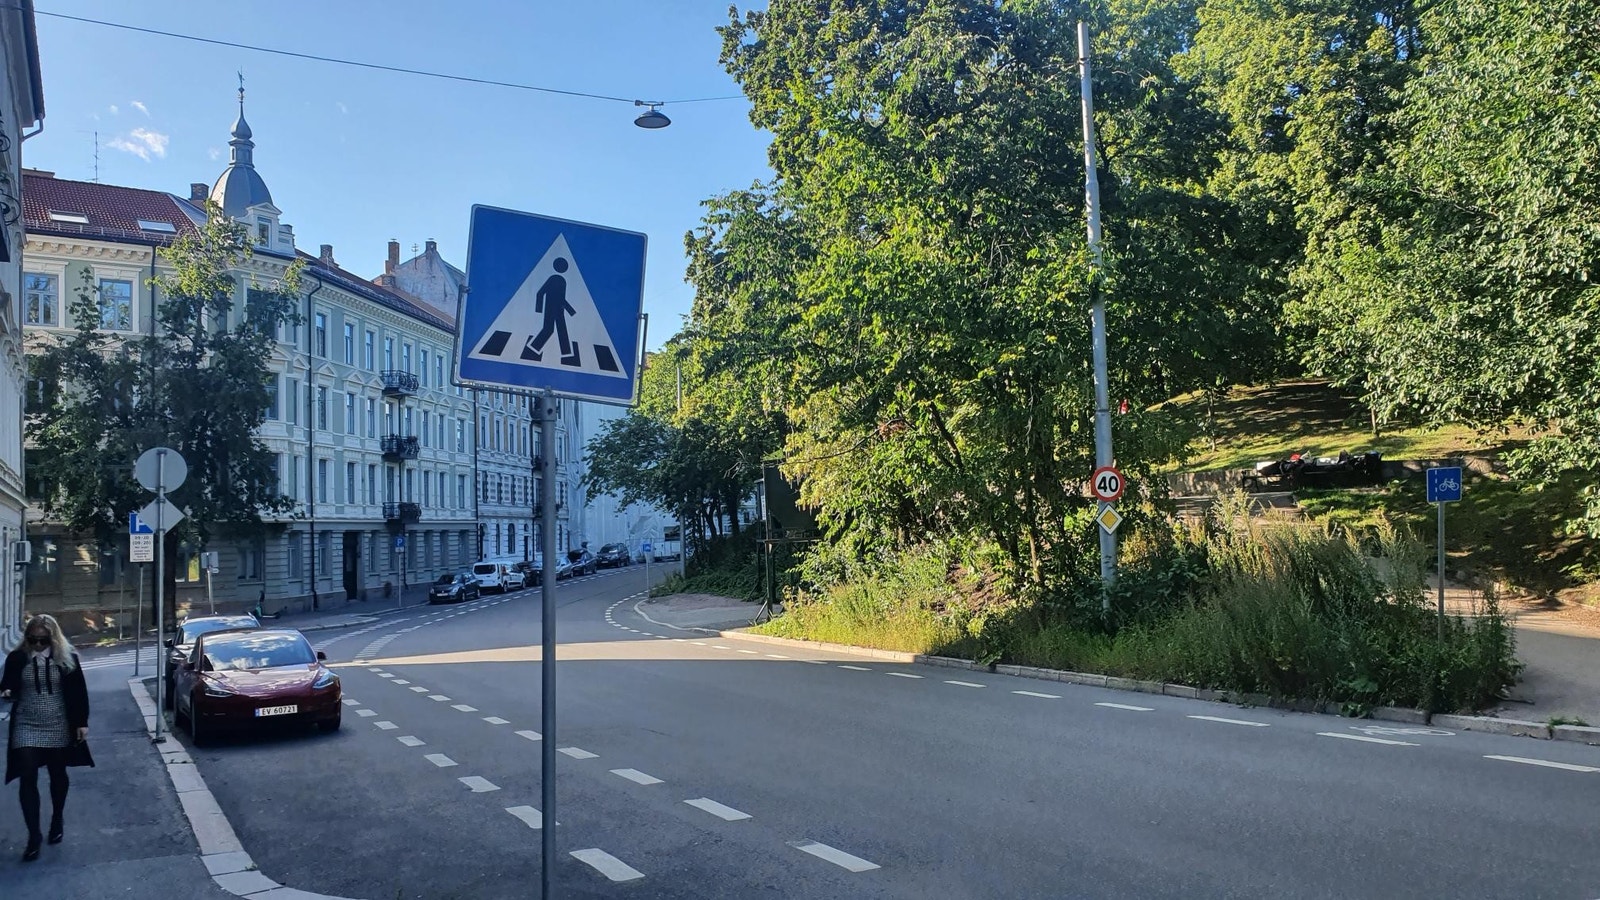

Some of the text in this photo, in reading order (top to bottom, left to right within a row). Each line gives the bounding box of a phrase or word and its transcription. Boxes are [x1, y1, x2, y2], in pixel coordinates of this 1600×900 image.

[1097, 476, 1119, 493] 40
[397, 538, 403, 546] P
[273, 706, 295, 714] 60721
